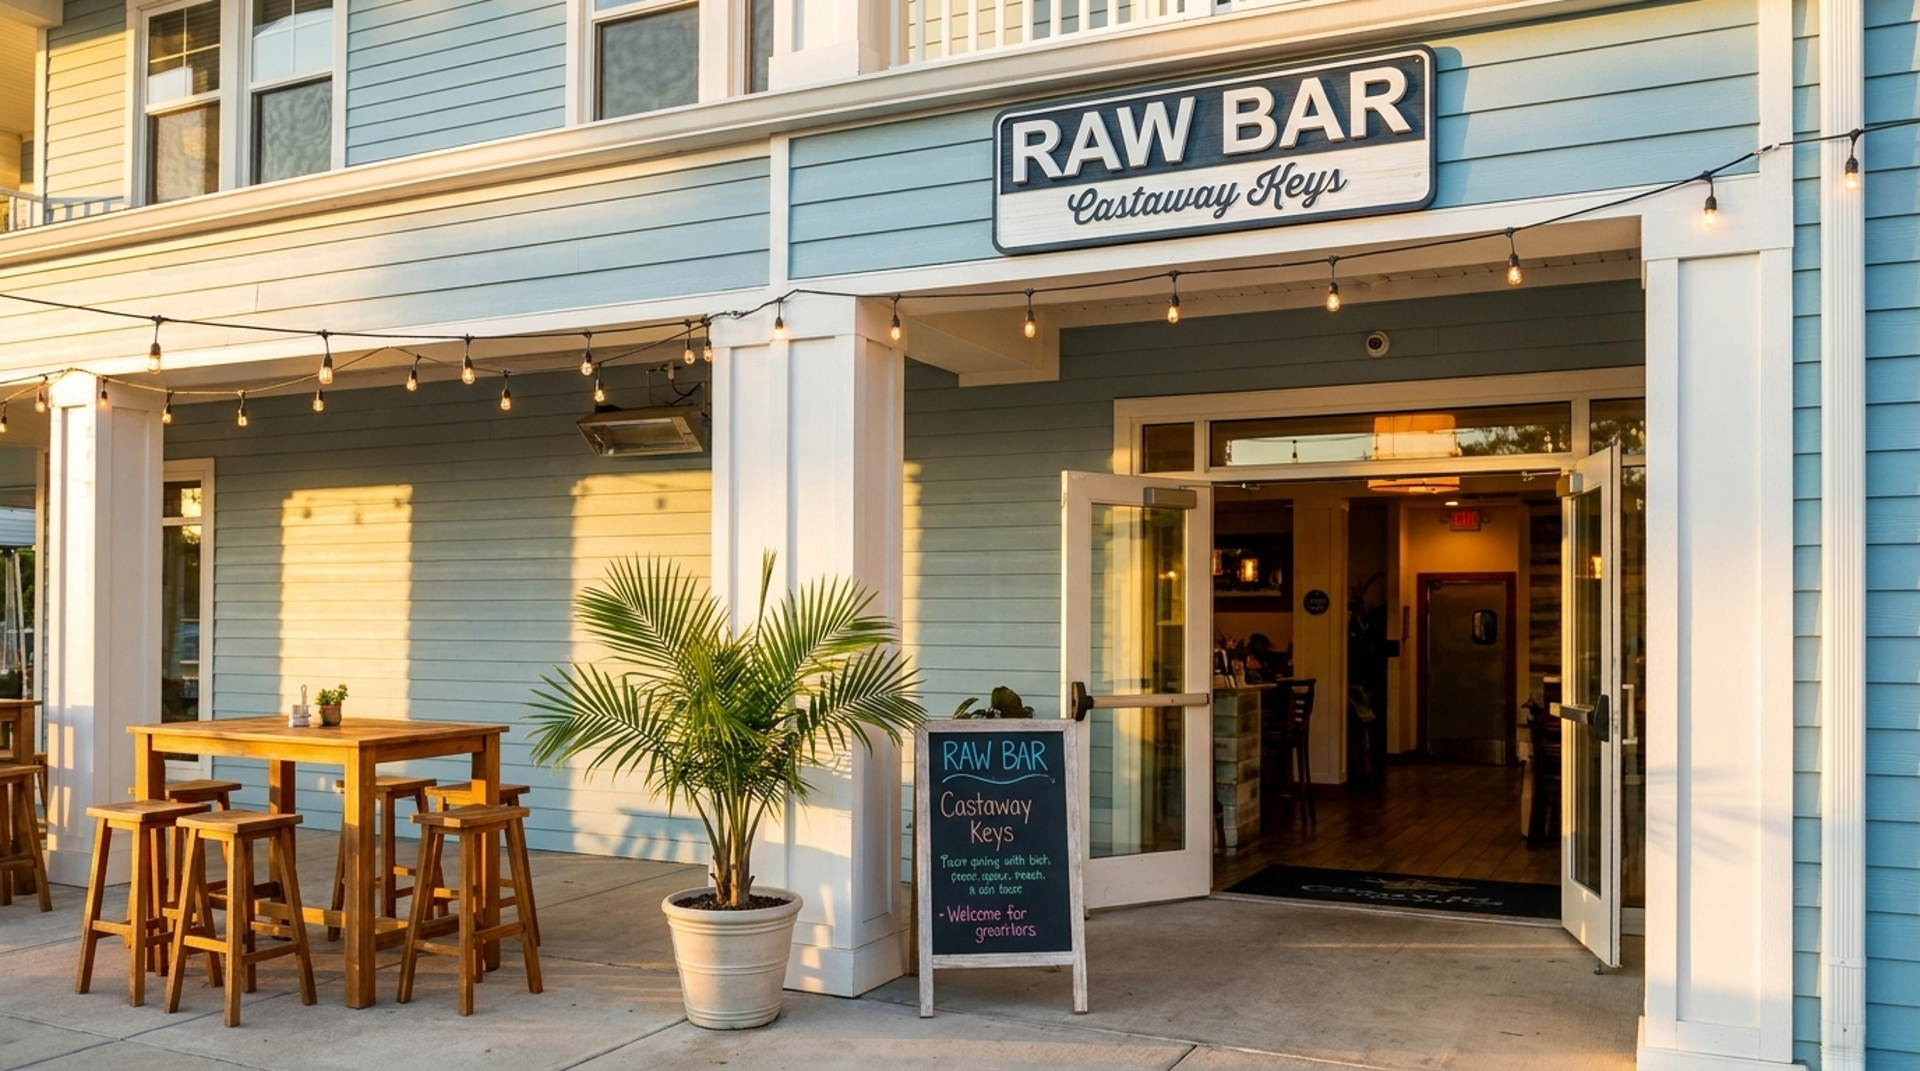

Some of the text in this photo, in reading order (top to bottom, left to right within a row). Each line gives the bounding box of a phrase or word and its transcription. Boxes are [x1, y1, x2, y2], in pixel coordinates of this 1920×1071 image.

[1011, 66, 1413, 184] RAW BAR
[1067, 161, 1348, 226] Castaway Keys
[942, 740, 1048, 772] RAW BAR
[940, 790, 1032, 824] Castaway
[971, 820, 1014, 851] Keys
[947, 905, 1001, 922] Welcome
[1006, 904, 1027, 920] for
